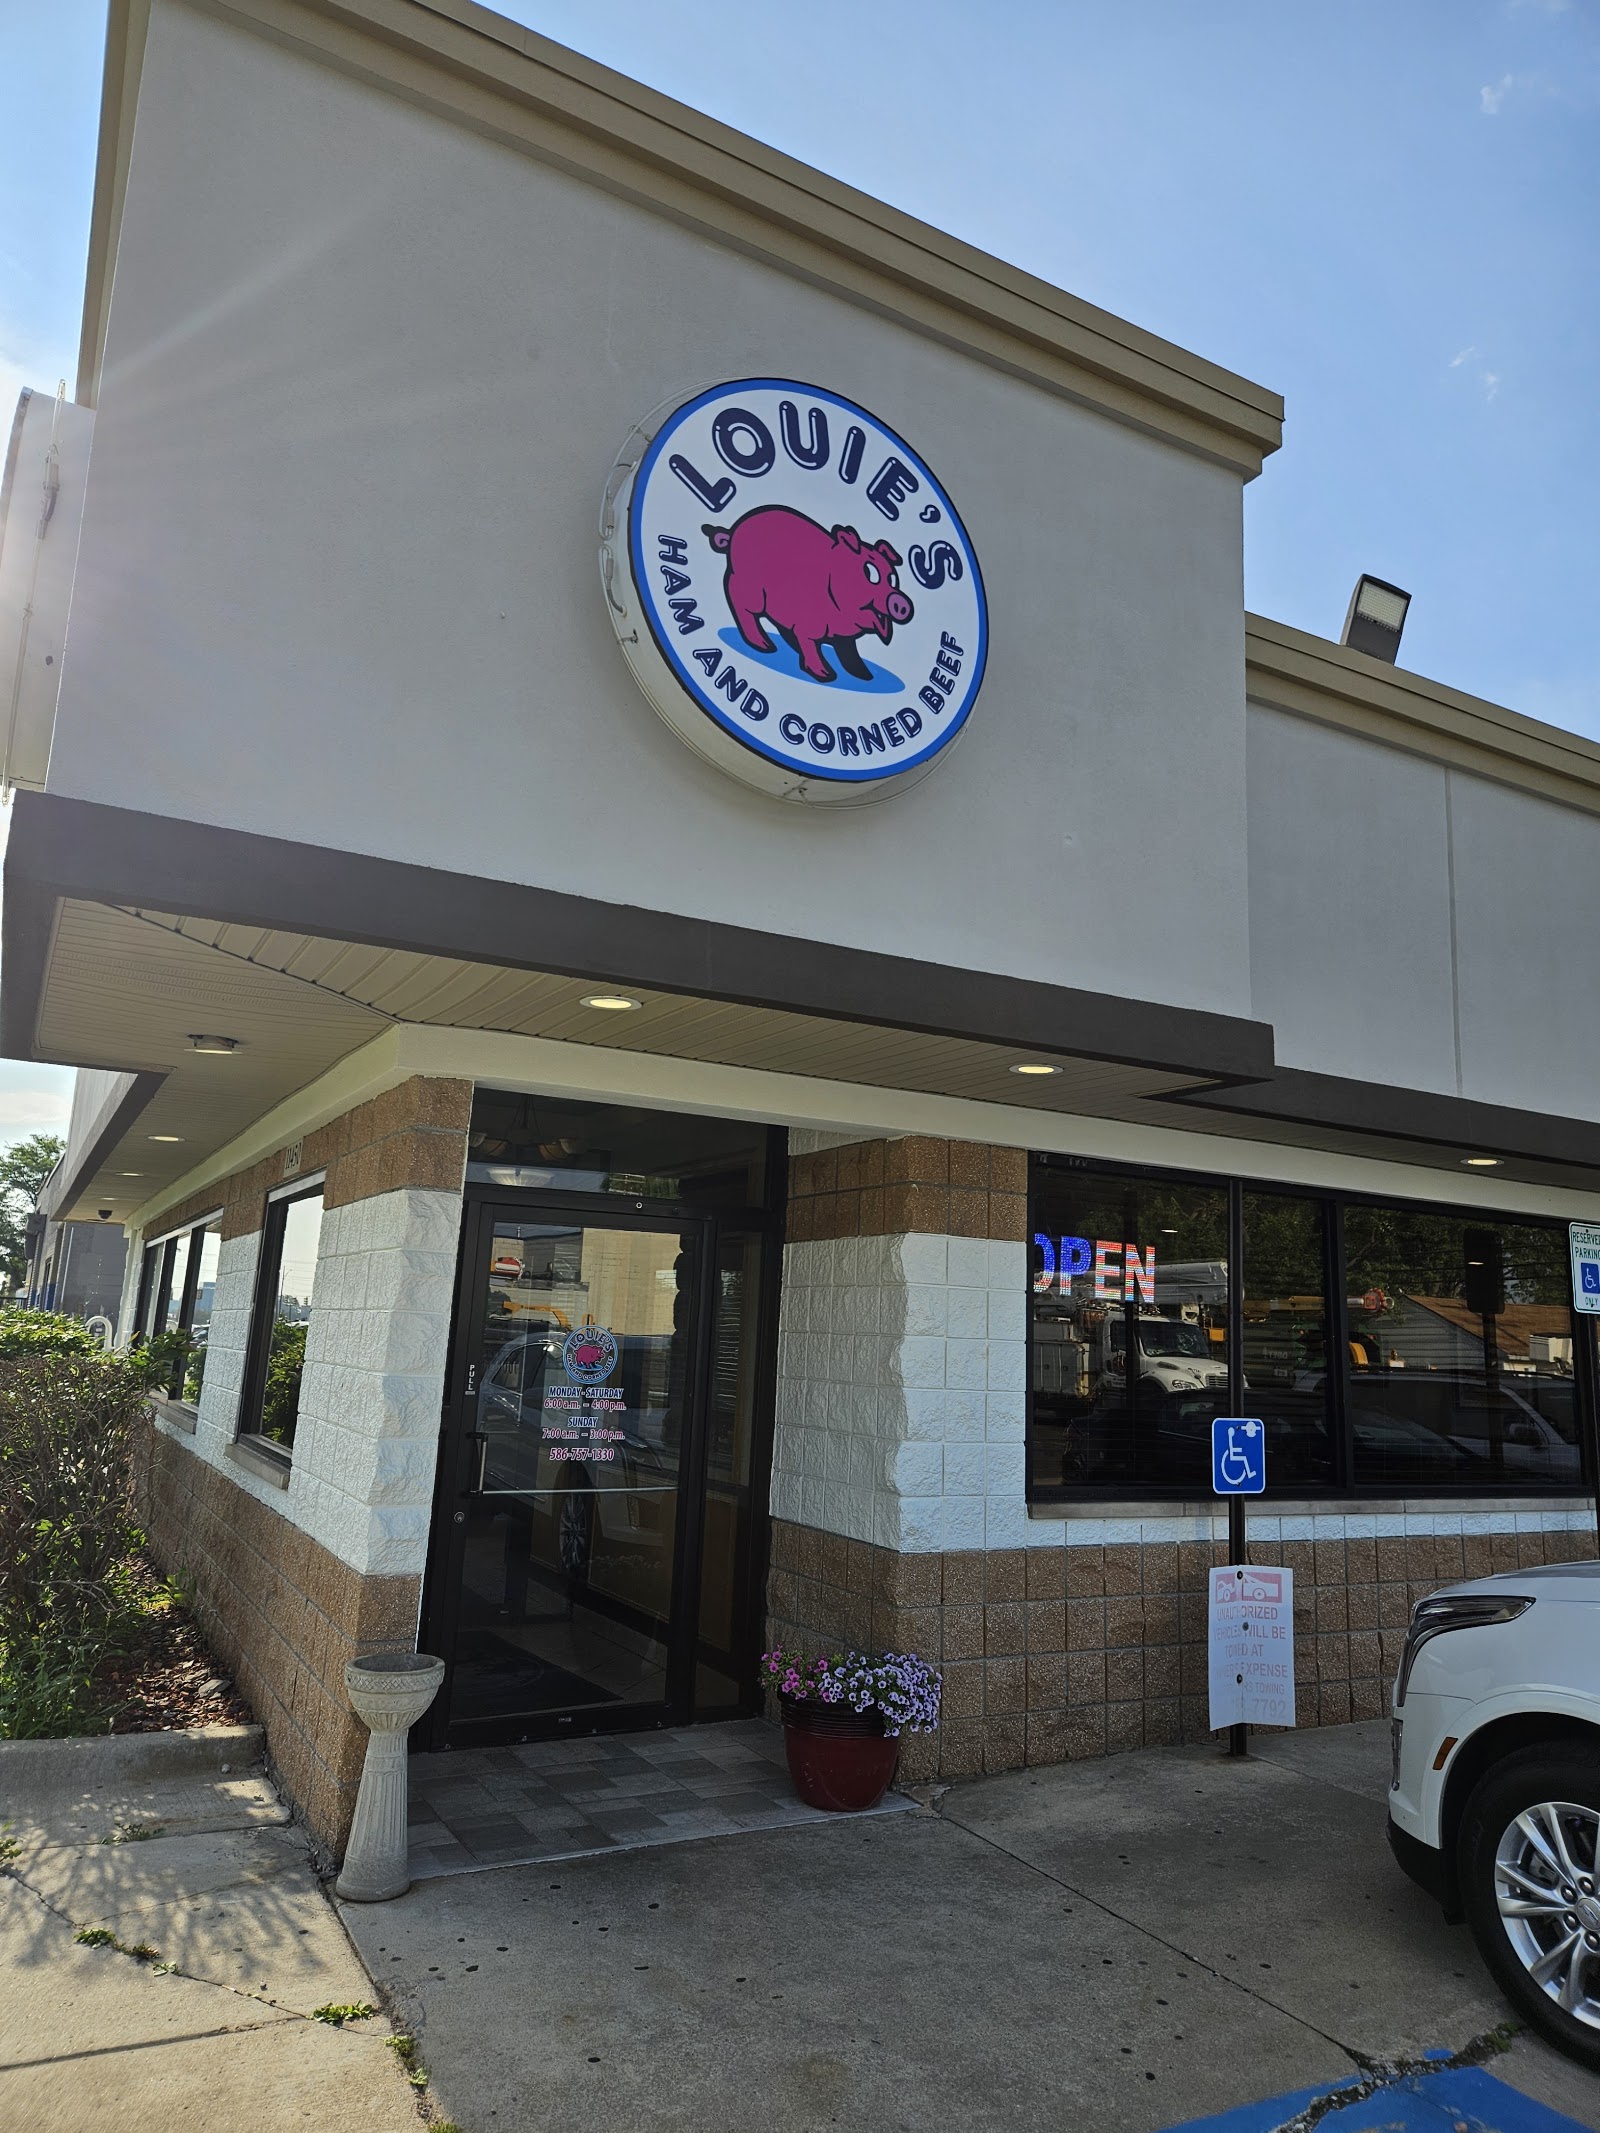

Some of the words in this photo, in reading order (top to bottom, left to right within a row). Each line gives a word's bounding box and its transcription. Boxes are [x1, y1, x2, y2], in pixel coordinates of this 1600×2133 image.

[668, 400, 964, 590] LOUIE'S
[658, 534, 705, 635] HAM
[693, 647, 770, 722] AND
[779, 707, 923, 757] CORNED
[919, 631, 965, 715] BEEF
[569, 1329, 614, 1352] LOUIE'S
[568, 1416, 598, 1427] SUNDAY
[1271, 1625, 1287, 1640] BE
[1224, 1643, 1249, 1658] TOWED
[1250, 1643, 1265, 1657] AT
[1255, 1682, 1285, 1695] TOWING
